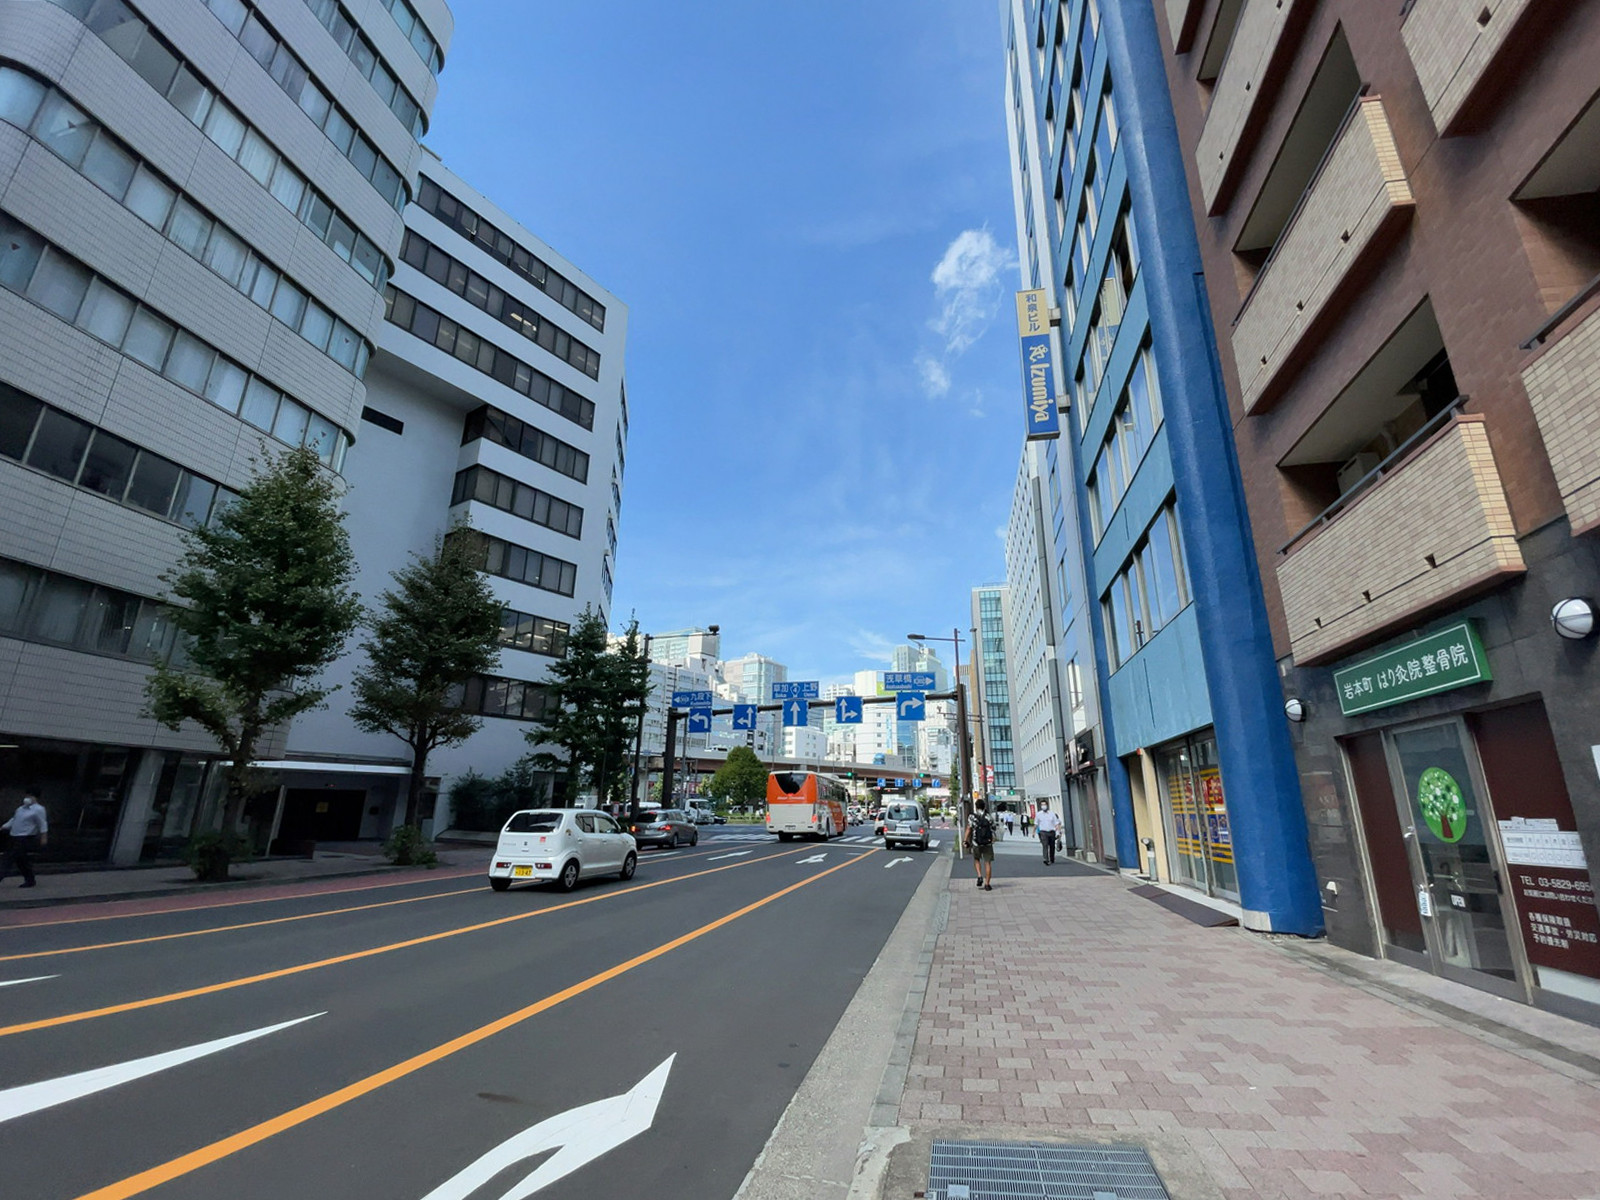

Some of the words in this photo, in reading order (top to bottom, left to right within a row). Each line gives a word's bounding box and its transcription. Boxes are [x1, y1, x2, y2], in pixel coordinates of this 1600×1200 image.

[1025, 293, 1040, 332] 和泉ビル
[1030, 362, 1054, 423] Izumiya
[802, 683, 817, 692] 上野
[1343, 676, 1373, 700] 岩本町
[1377, 642, 1468, 690] はり灸院整骨院
[1520, 875, 1535, 886] TEL
